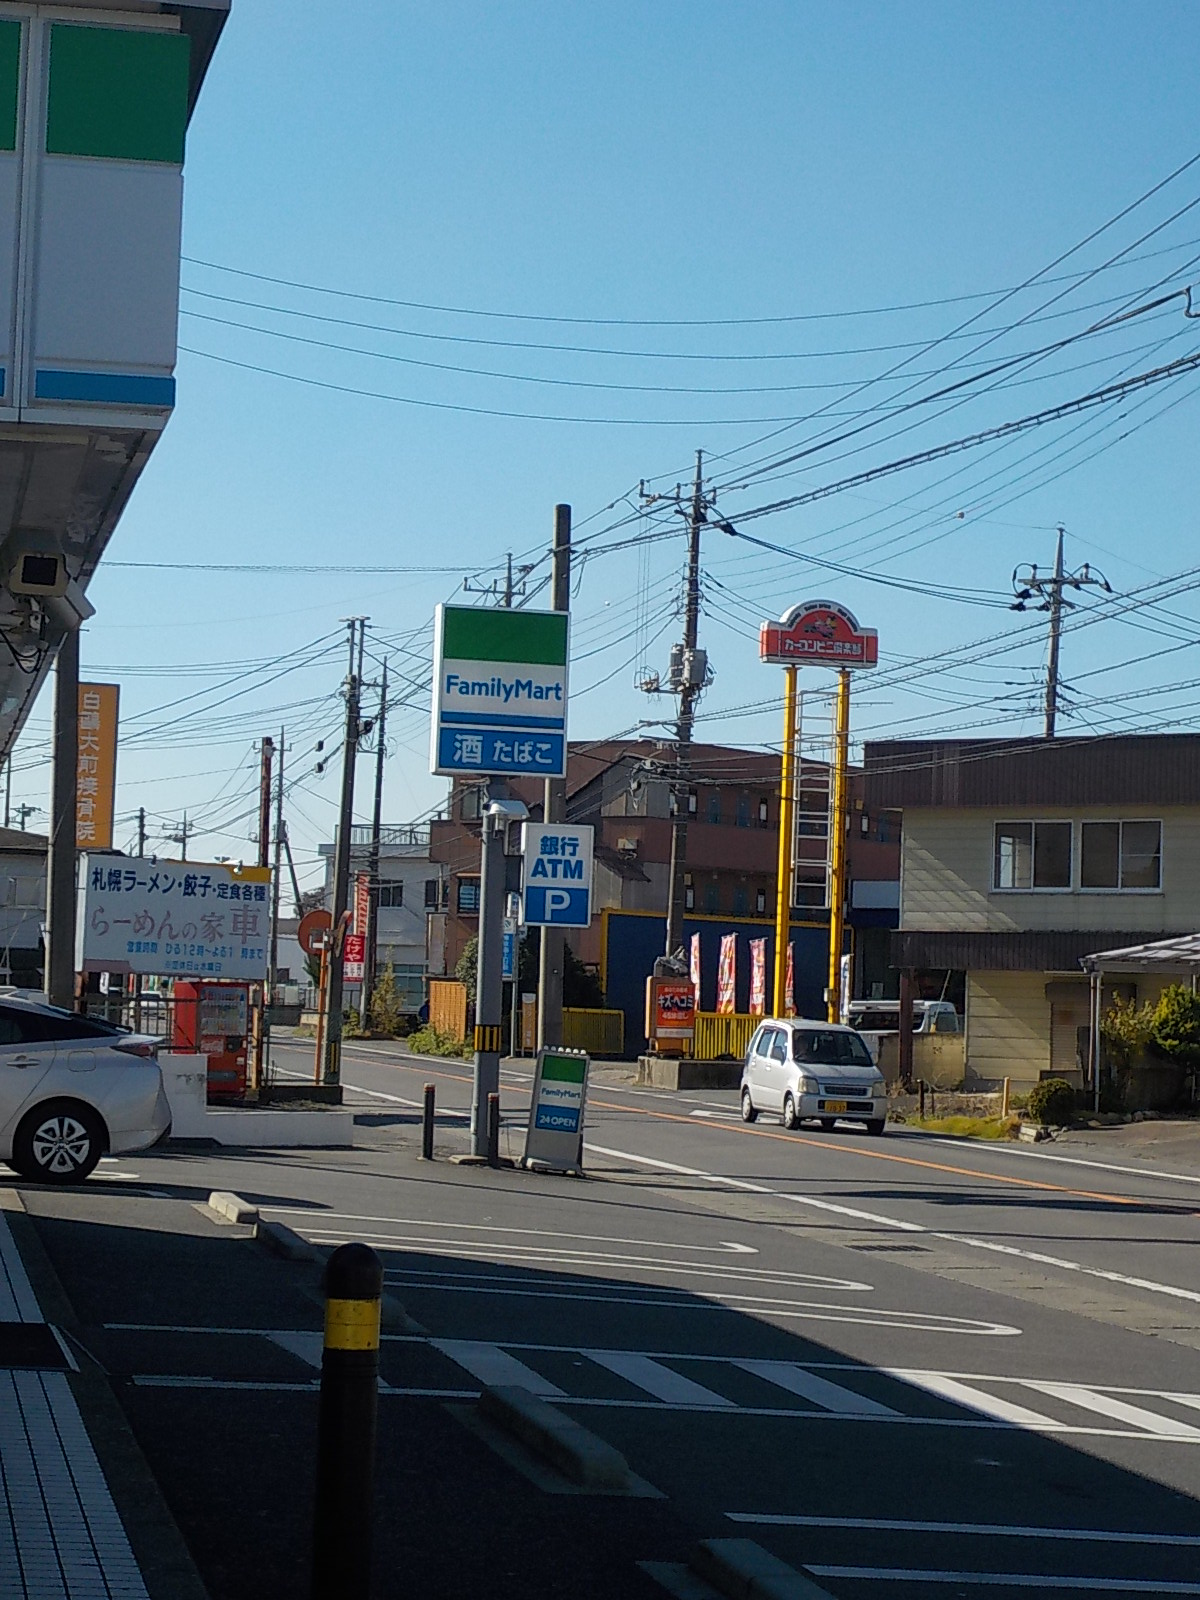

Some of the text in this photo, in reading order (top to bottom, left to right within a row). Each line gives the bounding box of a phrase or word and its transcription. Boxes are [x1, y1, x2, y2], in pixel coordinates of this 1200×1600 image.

[446, 675, 562, 703] FamilyMart
[453, 734, 553, 764] 酒 たばこ
[540, 835, 579, 857] 銀行
[531, 858, 583, 879] ATM
[544, 889, 571, 921] P
[346, 935, 362, 961] たけや
[541, 1087, 581, 1099] FamilyMart
[550, 1117, 576, 1128] OPEN
